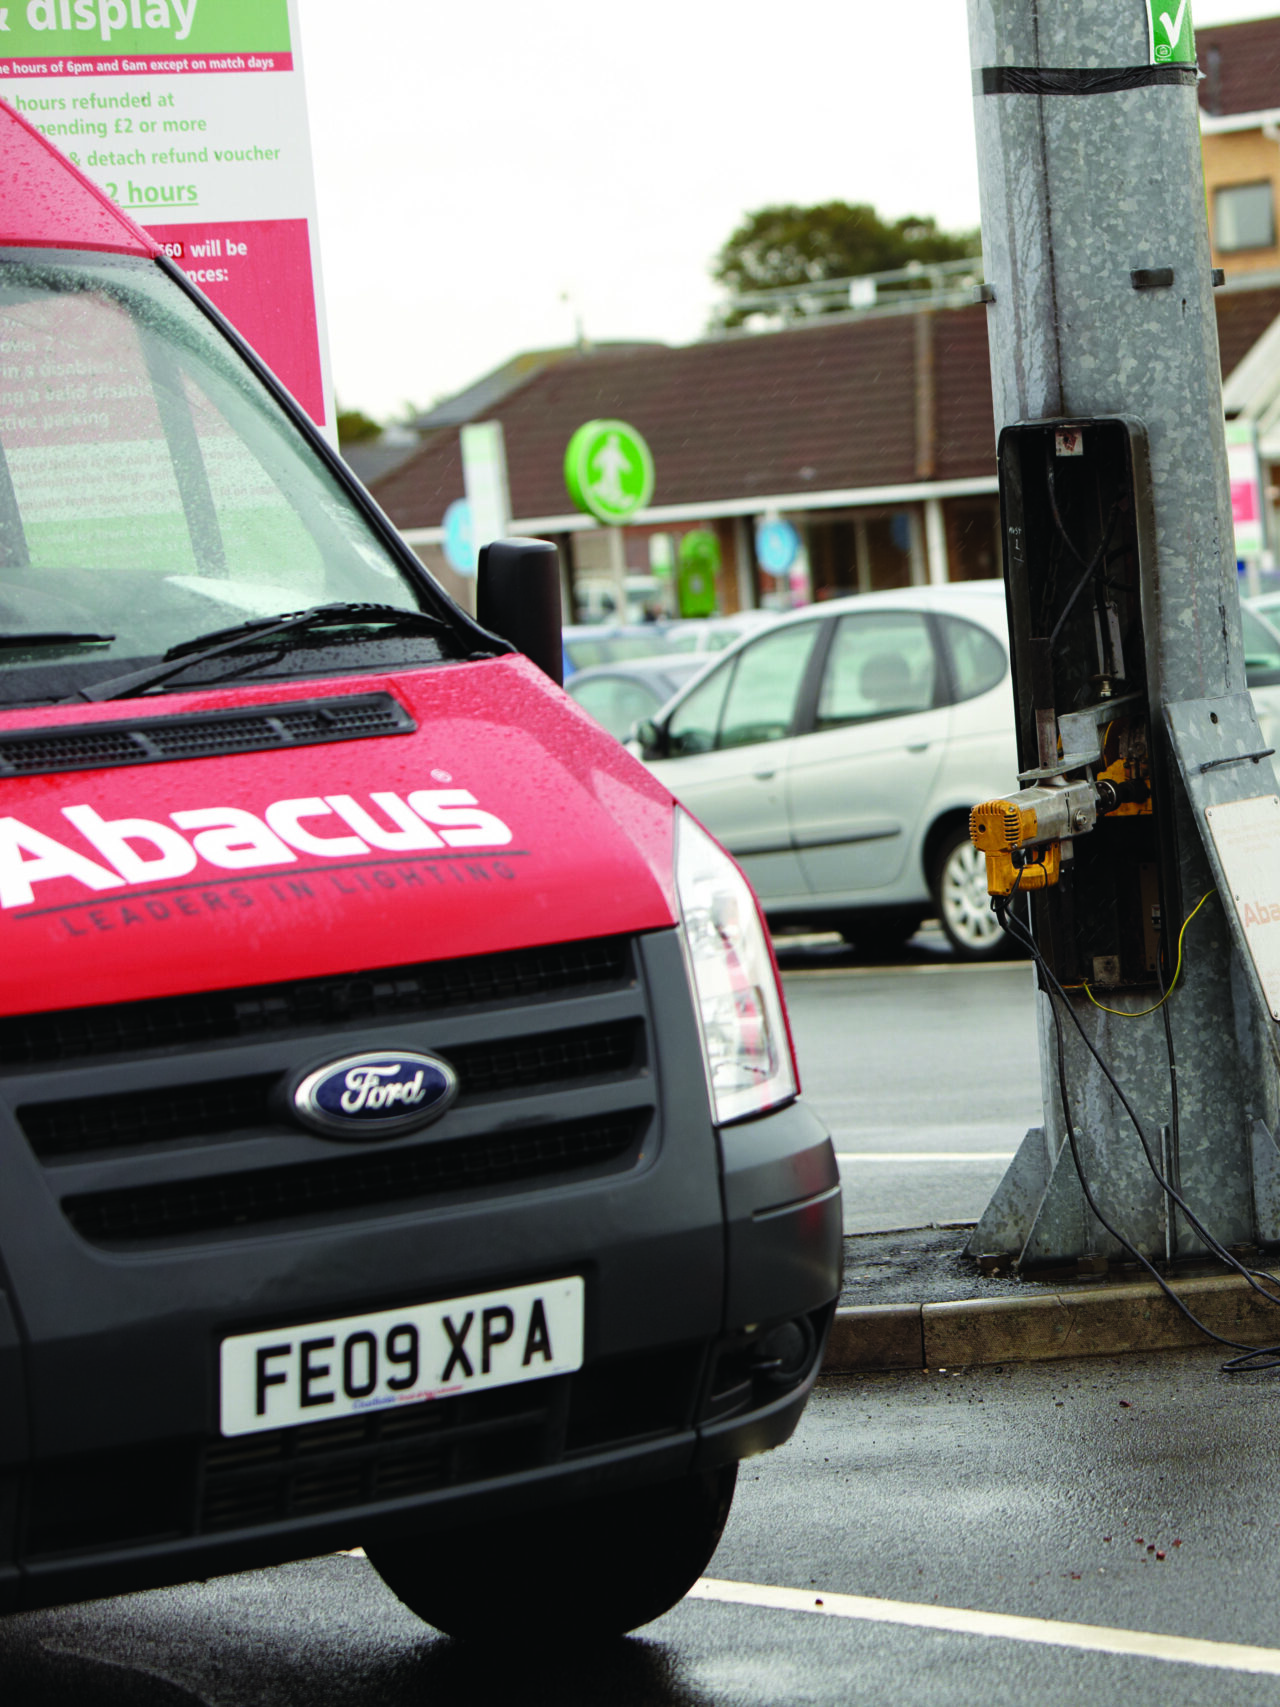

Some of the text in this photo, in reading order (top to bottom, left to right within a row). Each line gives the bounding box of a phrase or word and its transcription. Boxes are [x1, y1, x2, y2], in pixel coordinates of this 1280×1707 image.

[26, 0, 198, 40] display
[12, 61, 48, 75] hours
[51, 60, 64, 73] of
[67, 60, 94, 76] 6pm
[97, 59, 119, 73] and
[122, 58, 147, 72] 6am
[150, 58, 189, 73] except
[191, 59, 207, 71] on
[209, 56, 245, 70] match
[247, 55, 275, 71] days
[15, 94, 66, 111] hours
[72, 91, 152, 109] refunded
[157, 92, 175, 107] at
[114, 118, 133, 134] £2
[139, 120, 157, 133] or
[163, 118, 207, 132] more
[87, 149, 146, 167] detach
[152, 146, 208, 164] refund
[213, 144, 280, 162] voucher
[105, 180, 198, 203] 2 hours
[190, 239, 221, 258] will
[225, 238, 247, 256] be
[185, 268, 229, 282] nces:
[0, 788, 512, 908] Abacus
[61, 860, 516, 937] LEADERS IN LIGHTING
[341, 1064, 427, 1113] Ford
[255, 1297, 554, 1416] FE09 XPA
